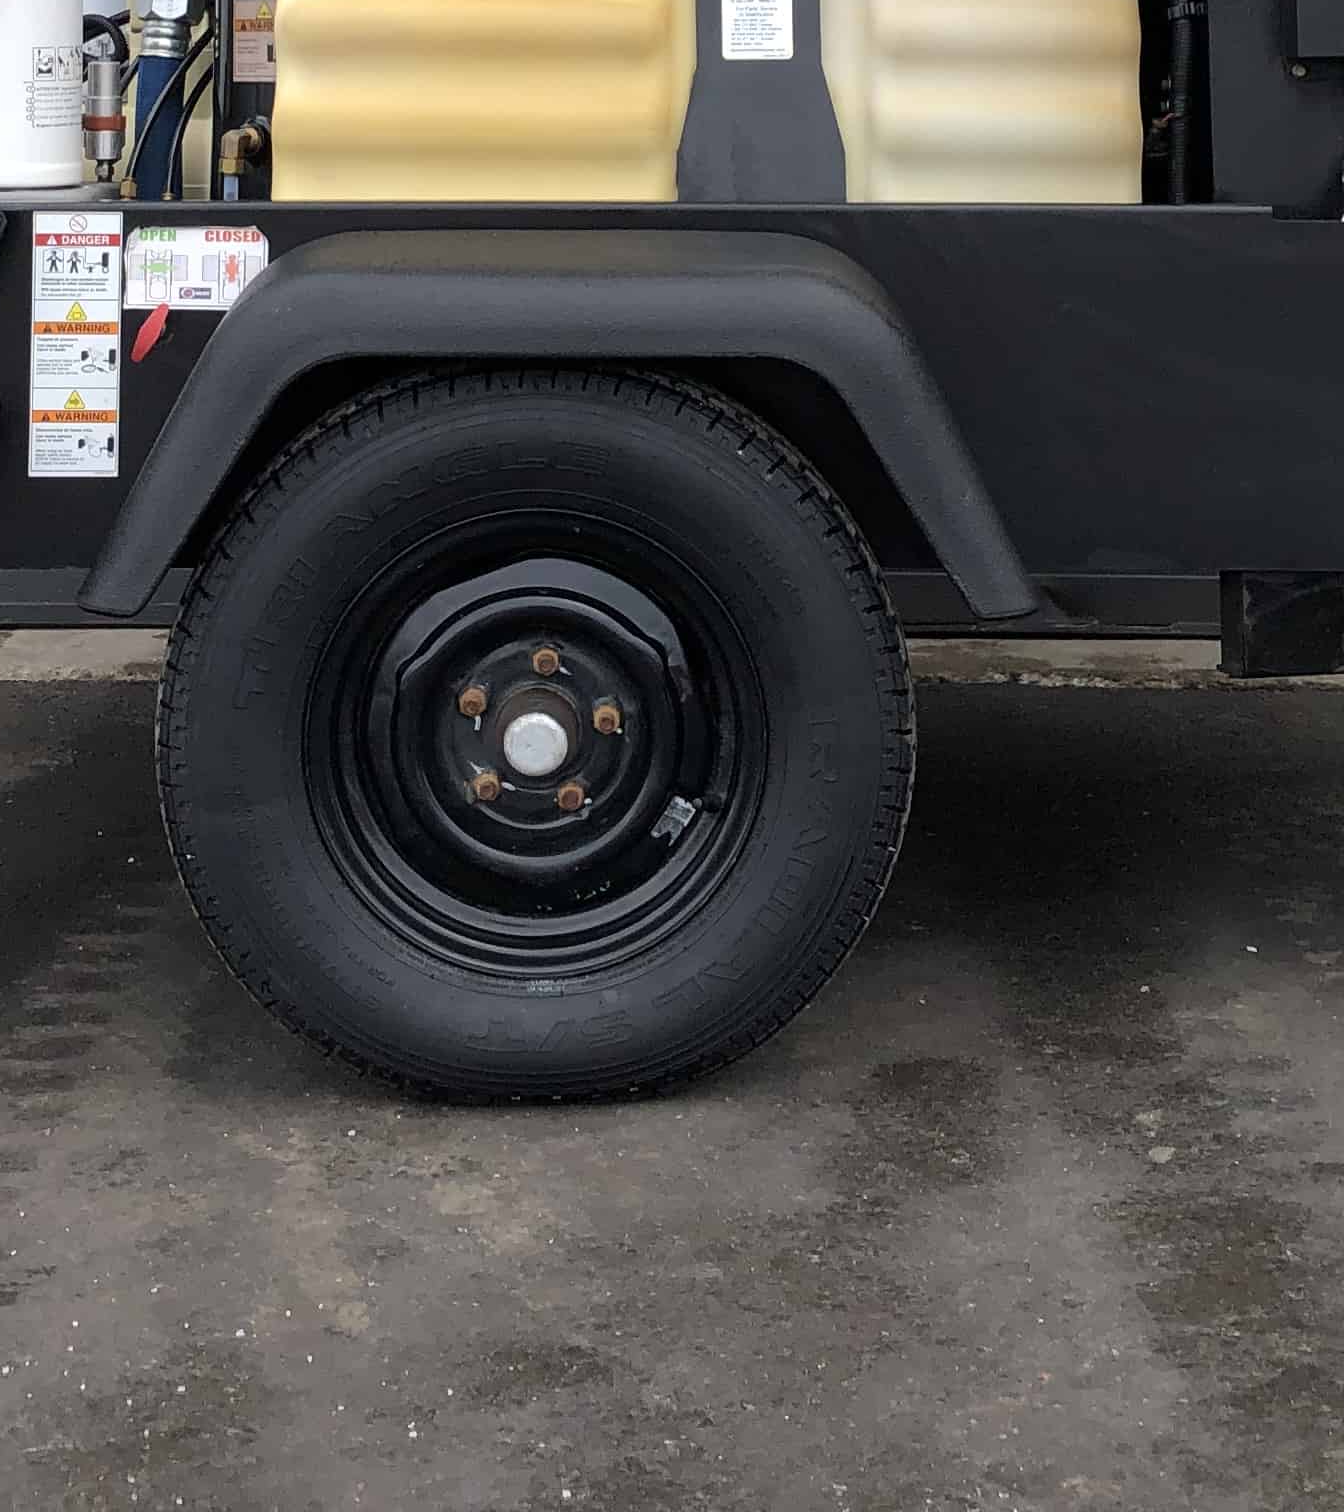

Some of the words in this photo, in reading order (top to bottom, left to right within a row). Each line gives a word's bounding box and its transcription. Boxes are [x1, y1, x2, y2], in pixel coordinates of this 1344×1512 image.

[61, 235, 110, 245] DANGER
[139, 229, 177, 242] OPEN
[204, 229, 261, 243] CLOSED
[56, 324, 110, 333] WARNING
[55, 412, 108, 421] WARNING
